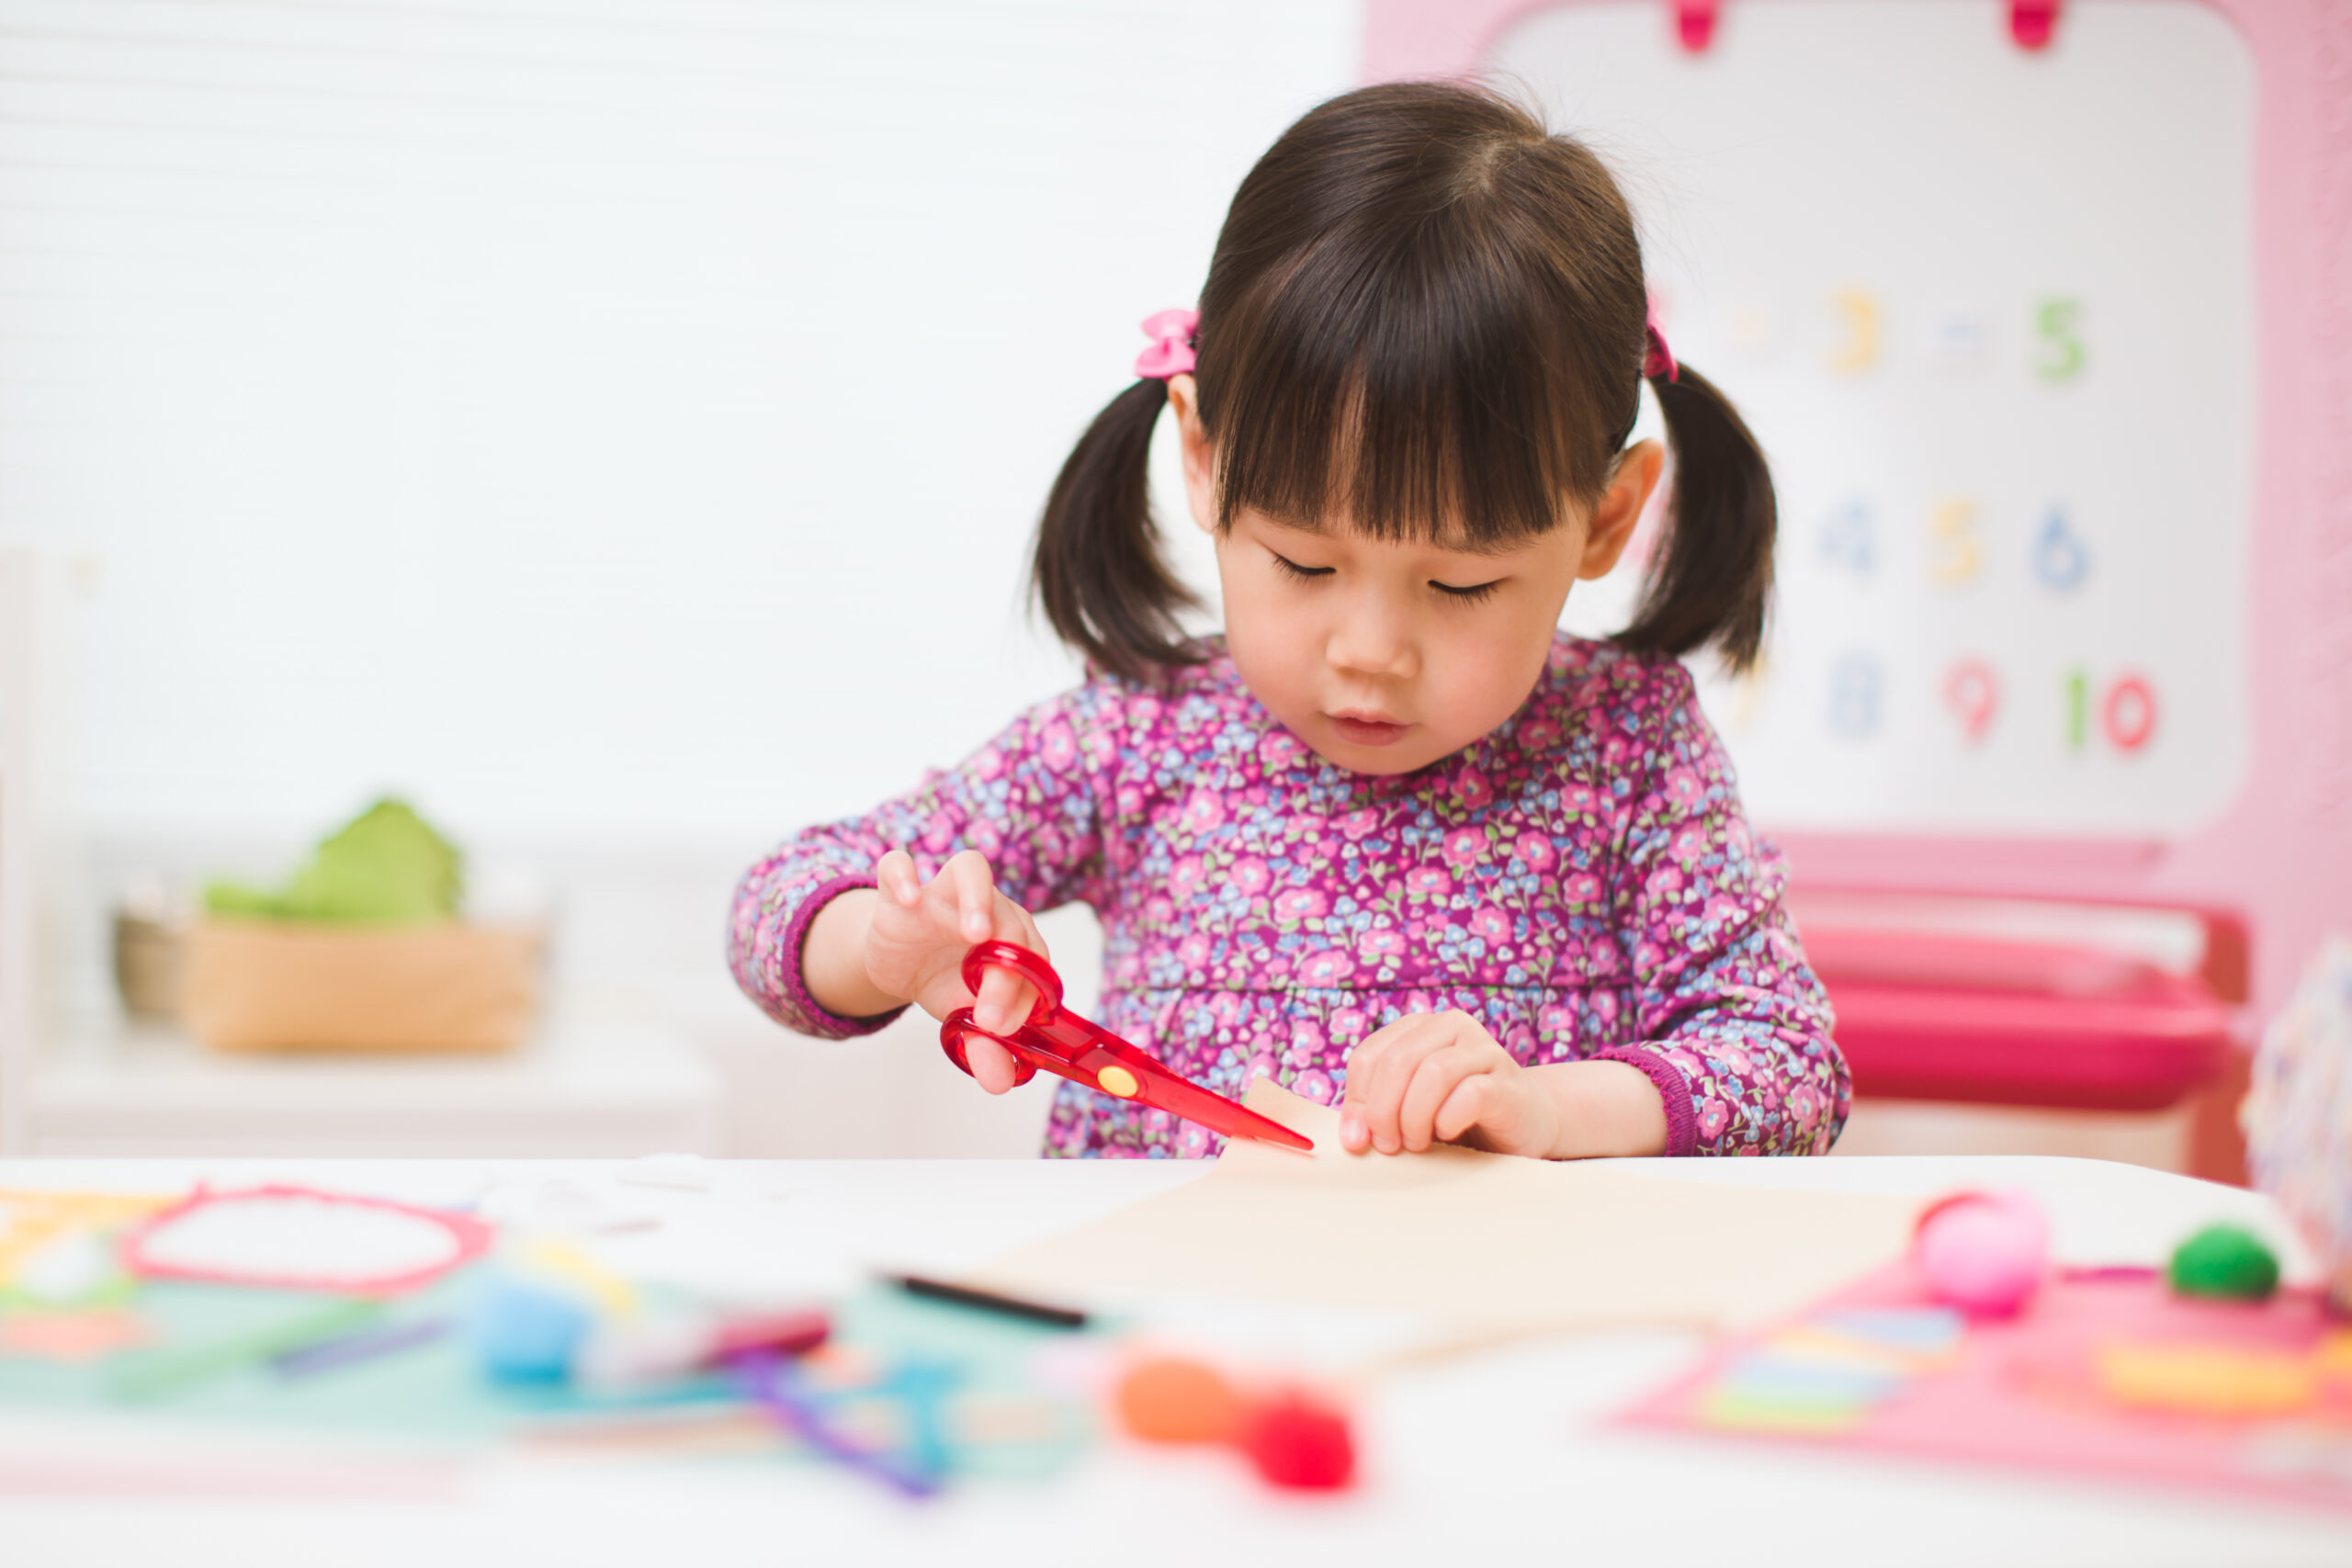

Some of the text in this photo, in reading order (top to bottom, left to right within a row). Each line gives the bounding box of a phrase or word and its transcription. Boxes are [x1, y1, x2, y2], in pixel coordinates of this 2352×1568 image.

[1827, 287, 1883, 375] 3
[2031, 294, 2090, 384] 5
[1819, 498, 2092, 593] 4 5 6
[1828, 651, 1885, 739] 8
[1940, 656, 2002, 748] 9
[2063, 666, 2158, 758] 10
